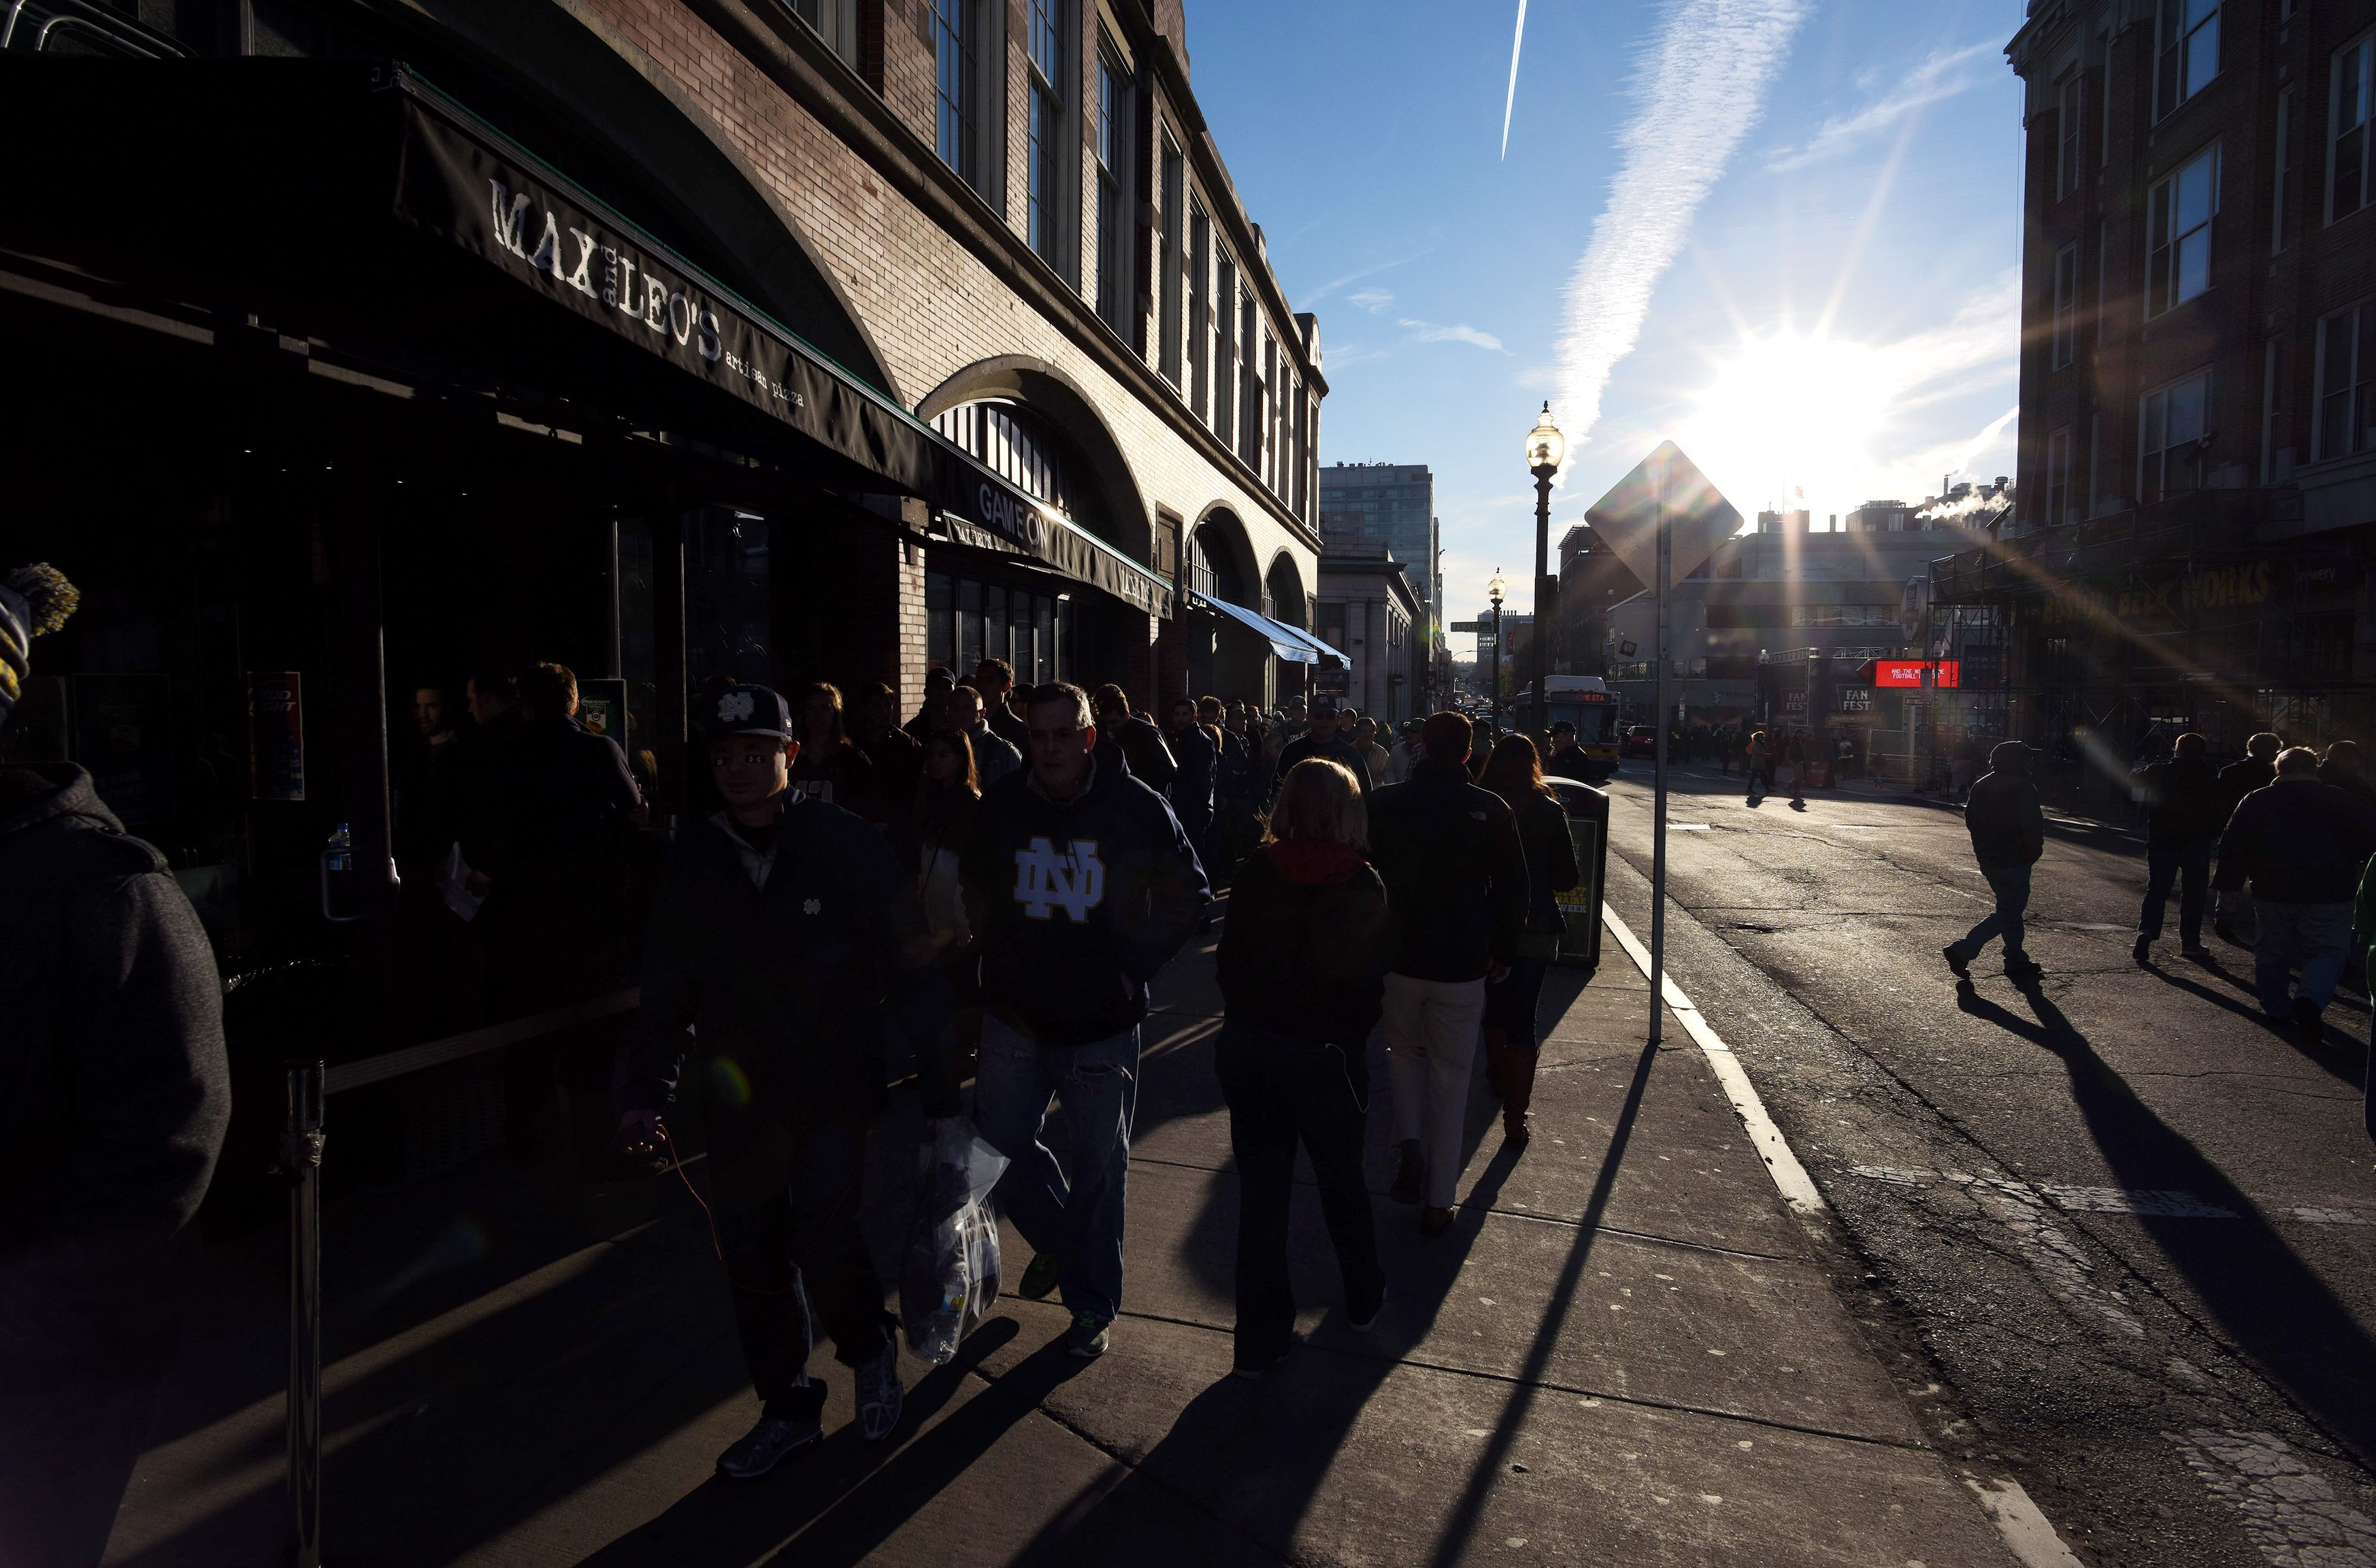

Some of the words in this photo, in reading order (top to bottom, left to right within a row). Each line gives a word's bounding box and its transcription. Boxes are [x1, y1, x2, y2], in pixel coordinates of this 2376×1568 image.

[489, 178, 601, 299] MAX
[600, 244, 617, 309] and
[618, 255, 722, 362] LEO'S
[726, 350, 768, 390] artisan
[772, 380, 804, 407] pizza
[979, 482, 1024, 540] GAME
[1026, 512, 1049, 550] ON
[2182, 561, 2271, 610] WORKS
[248, 701, 297, 717] LGHT
[1592, 694, 1606, 702] STA
[1843, 701, 1871, 711] FEST
[1846, 690, 1868, 700] FAN
